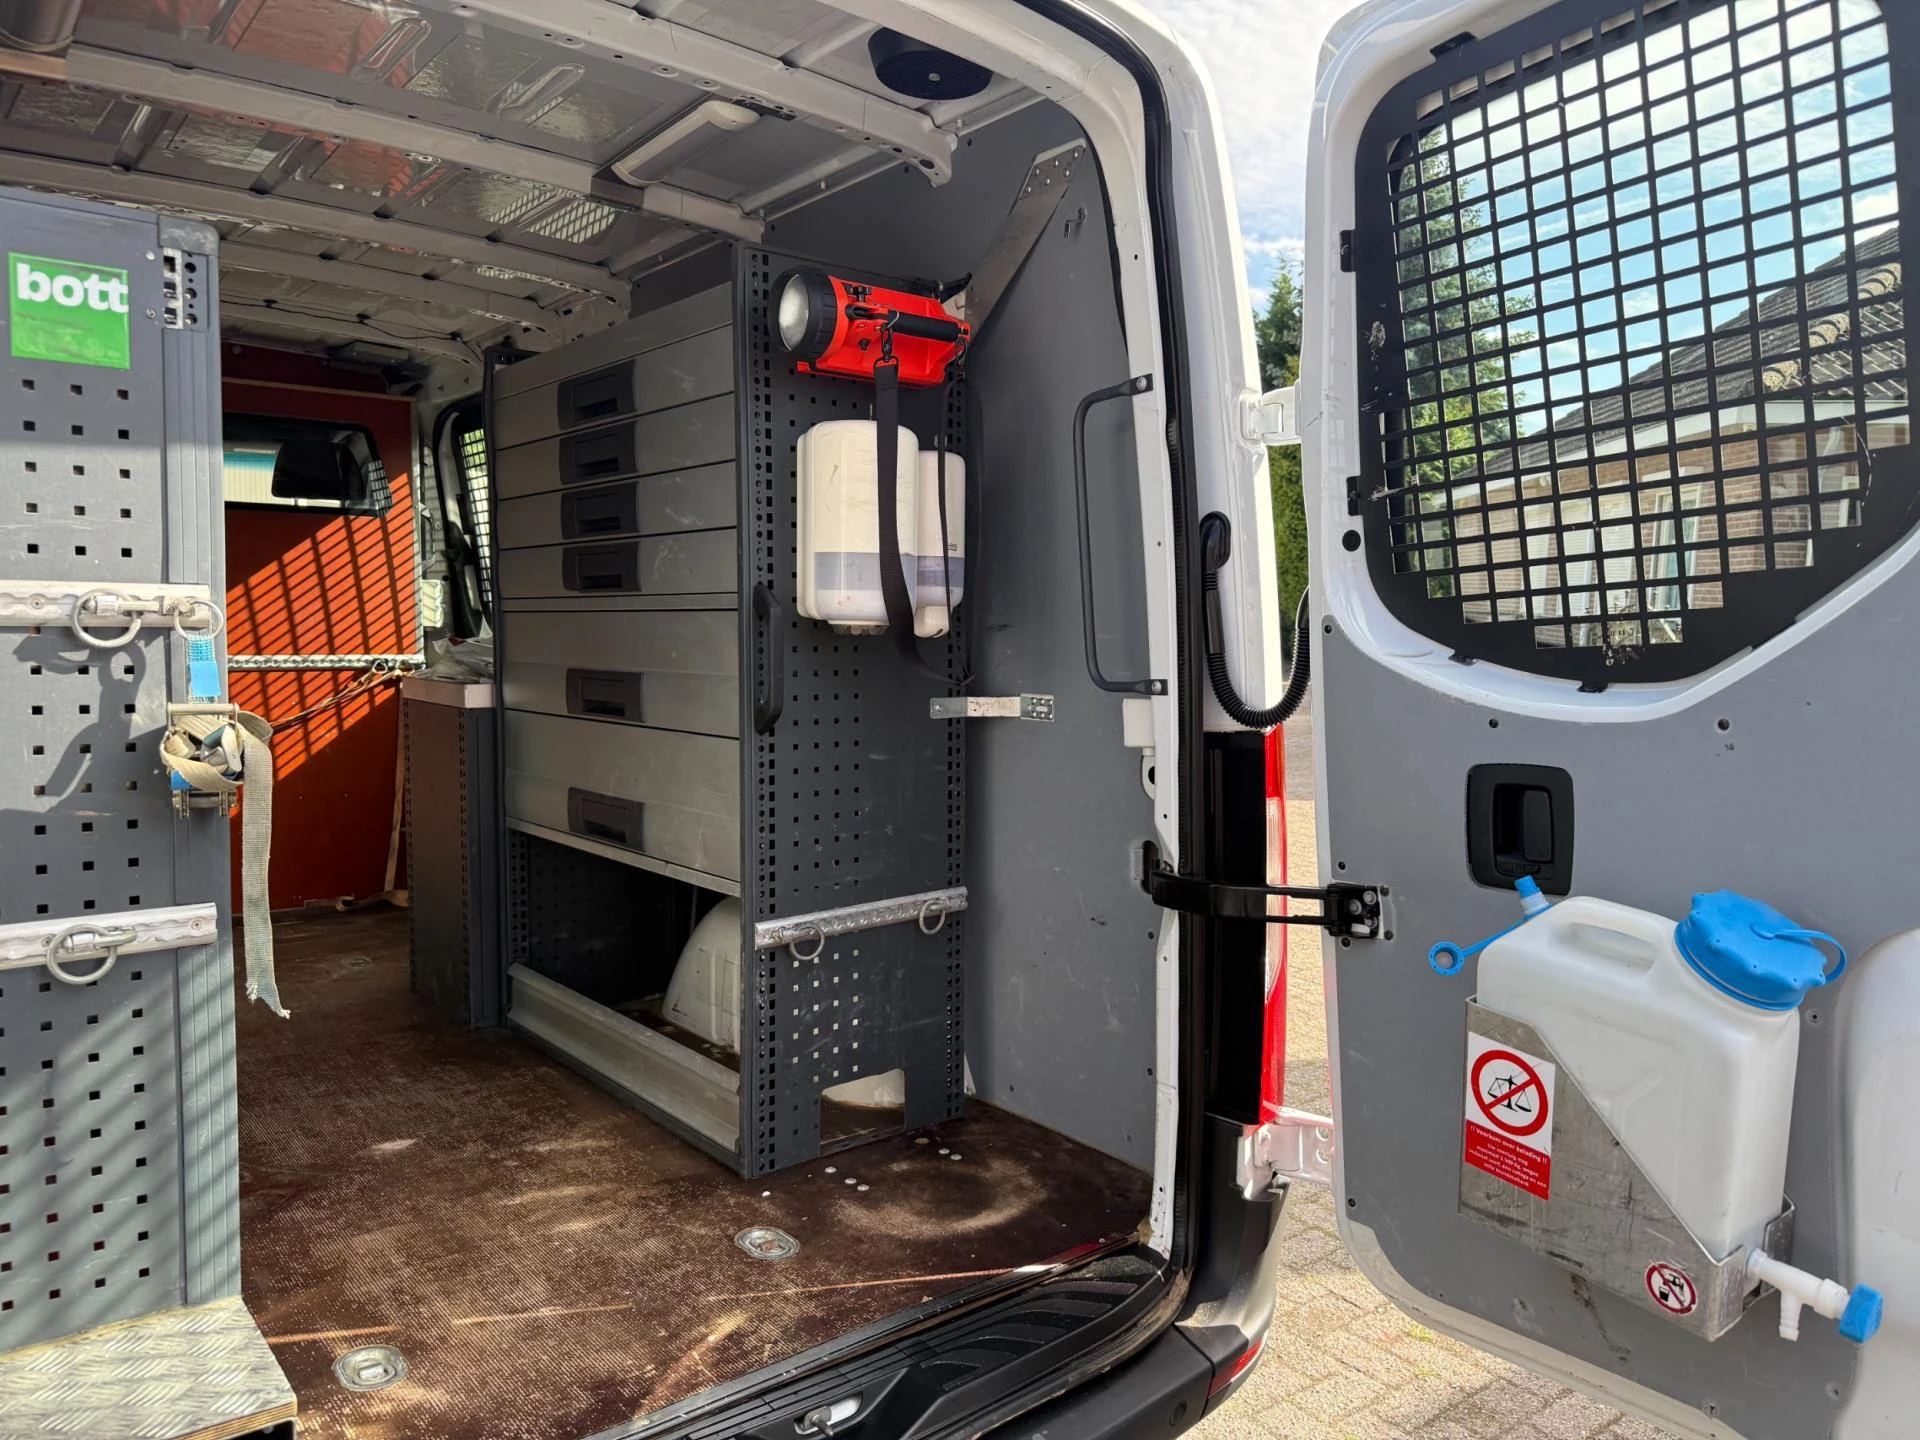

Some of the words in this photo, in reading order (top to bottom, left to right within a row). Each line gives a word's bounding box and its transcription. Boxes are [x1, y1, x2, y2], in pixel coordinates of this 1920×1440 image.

[16, 262, 129, 313] bott
[1476, 1127, 1501, 1143] Voorkom
[1501, 1140, 1515, 1150] over
[1516, 1145, 1541, 1162] belading
[1517, 1156, 1528, 1166] mag
